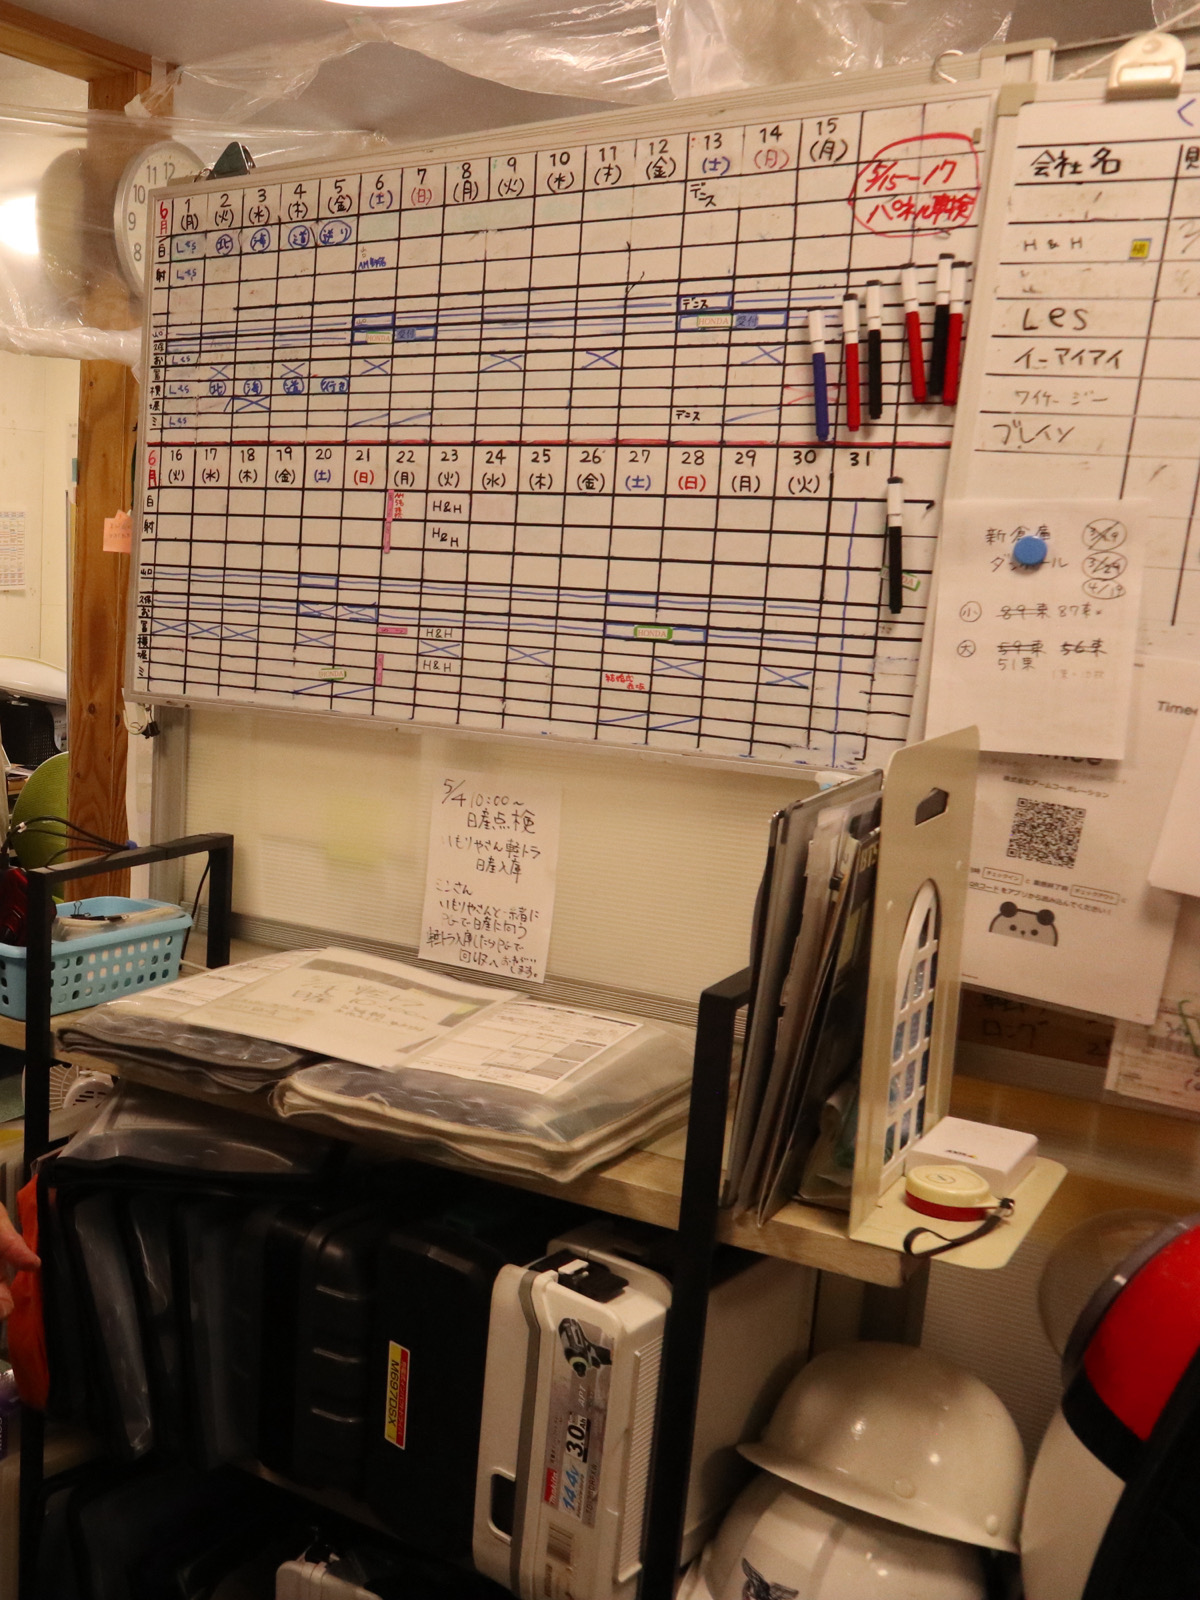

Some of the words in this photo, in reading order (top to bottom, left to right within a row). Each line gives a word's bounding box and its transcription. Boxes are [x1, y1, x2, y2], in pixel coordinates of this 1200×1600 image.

[164, 162, 175, 180] 12
[184, 198, 191, 213] 1
[220, 193, 231, 208] 2
[257, 189, 267, 203] 3
[293, 183, 307, 199] 4
[334, 179, 346, 194] 5
[375, 174, 384, 190] 6
[417, 168, 427, 184] 7
[461, 162, 471, 179] 8
[507, 157, 517, 173] 9
[550, 151, 571, 167] 10
[599, 146, 618, 162] 11
[649, 139, 669, 156] 12
[703, 132, 722, 150] 13
[759, 125, 782, 143] 14
[817, 118, 839, 135] 15
[1030, 147, 1121, 178] 会社名
[146, 165, 157, 185] 11
[133, 184, 145, 204] 10
[128, 212, 136, 230] 9
[133, 243, 141, 262] 8
[698, 316, 729, 325] HONDA
[1023, 307, 1089, 330] Les
[170, 450, 182, 461] 16
[204, 448, 218, 461] 17
[240, 448, 255, 463] 18
[276, 446, 293, 461] 19
[315, 448, 332, 460] 20
[356, 448, 370, 461] 21
[396, 450, 416, 463] 22
[440, 449, 459, 462] 23
[485, 449, 506, 465] 24
[531, 448, 551, 463] 25
[579, 448, 602, 464] 26
[629, 449, 650, 463] 27
[681, 450, 705, 466] 28
[735, 450, 757, 467] 29
[793, 450, 817, 465] 30
[850, 451, 870, 466] 31
